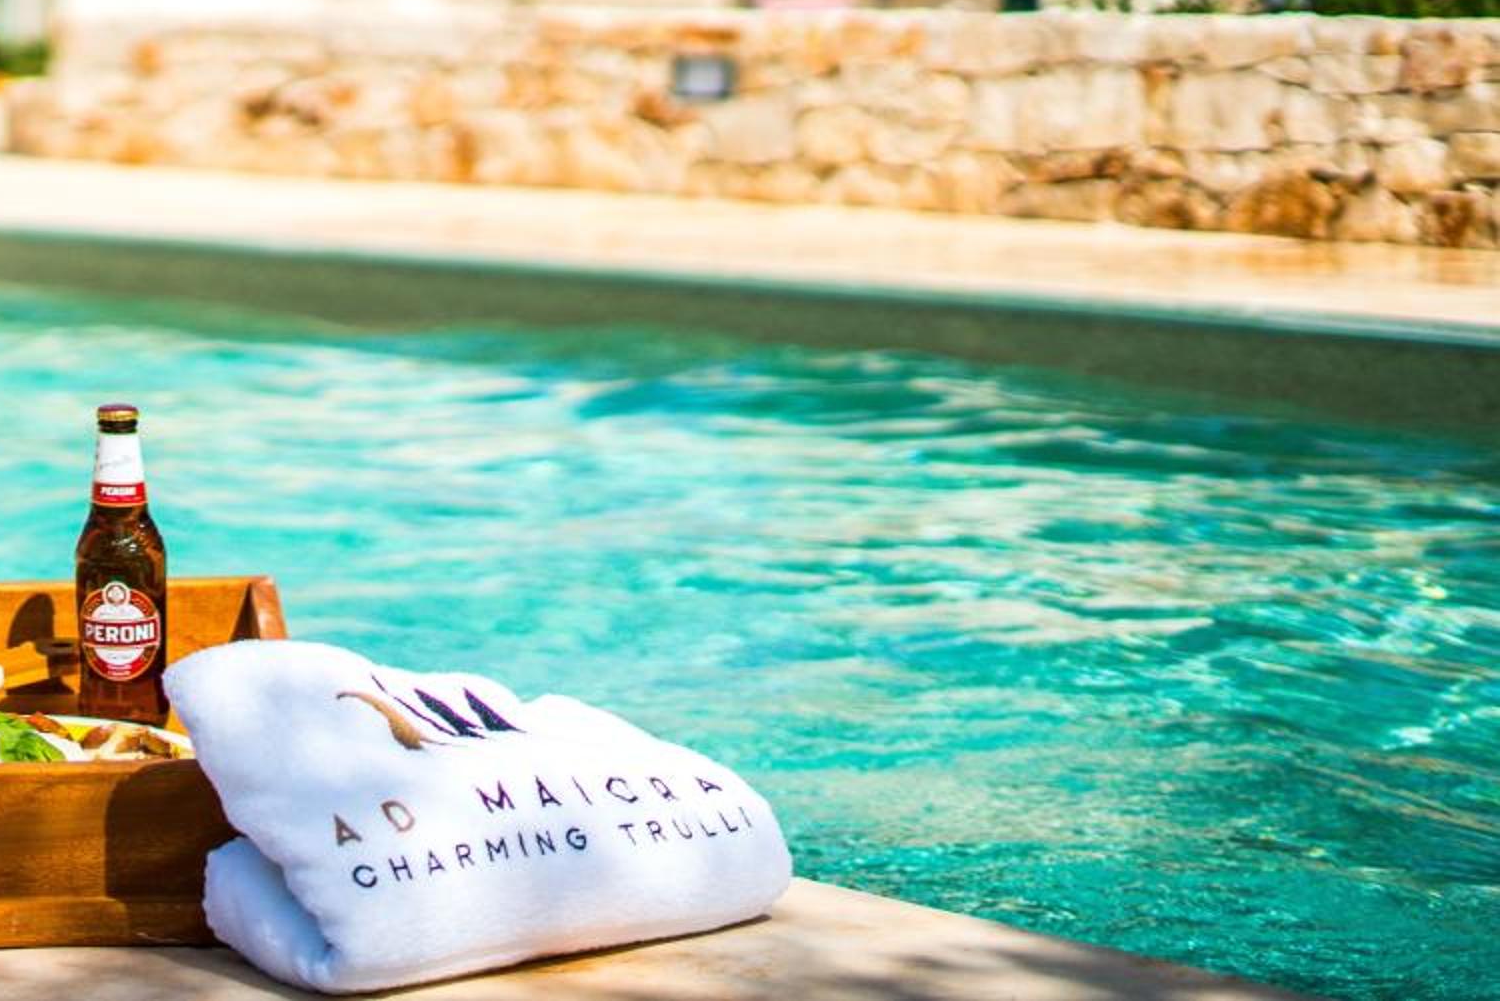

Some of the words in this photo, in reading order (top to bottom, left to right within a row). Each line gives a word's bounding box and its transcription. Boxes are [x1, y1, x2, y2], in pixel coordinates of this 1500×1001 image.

[85, 622, 155, 643] PERONI
[333, 800, 415, 847] AD
[352, 827, 587, 888] CHARMING
[618, 806, 752, 846] TRULLI
